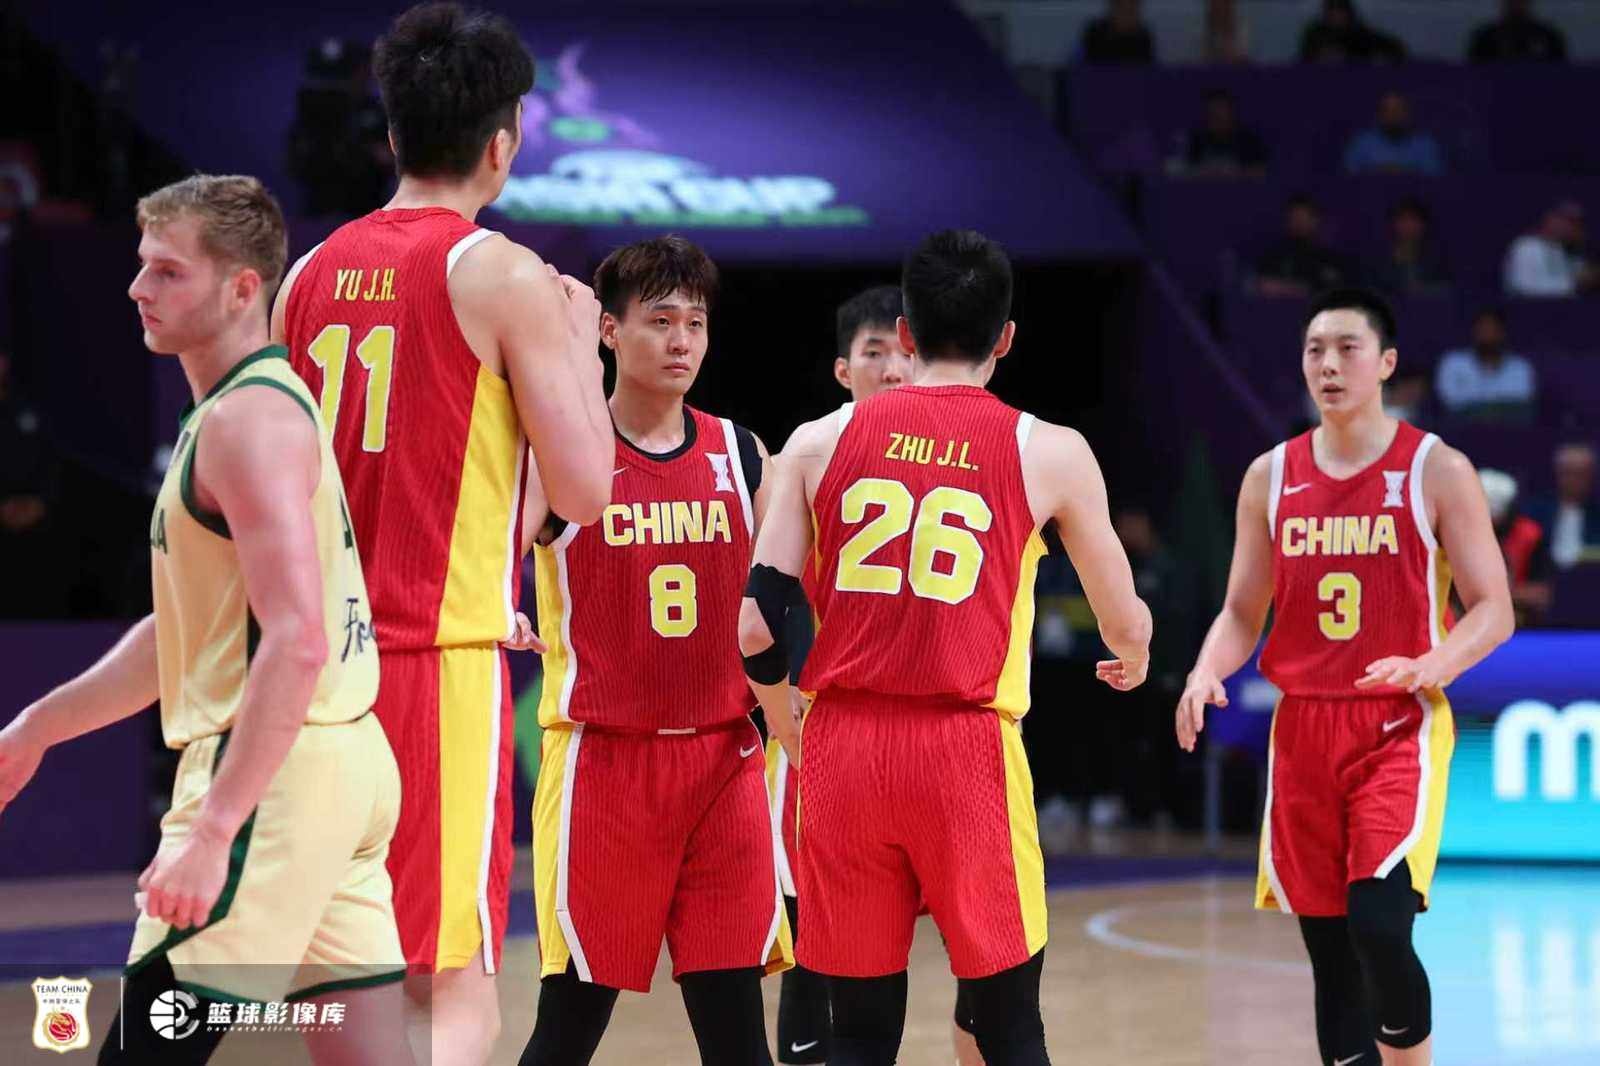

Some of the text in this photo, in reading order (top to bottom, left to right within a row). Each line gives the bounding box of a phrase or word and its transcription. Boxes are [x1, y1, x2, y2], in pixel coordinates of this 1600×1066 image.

[334, 268, 396, 301] YU J.H.
[308, 324, 395, 452] 11
[885, 432, 980, 471] ZHU J.L.
[603, 500, 732, 546] CHINA
[835, 478, 993, 605] 26
[1281, 514, 1399, 557] CHINA
[649, 564, 698, 638] 8
[1318, 572, 1361, 640] 3
